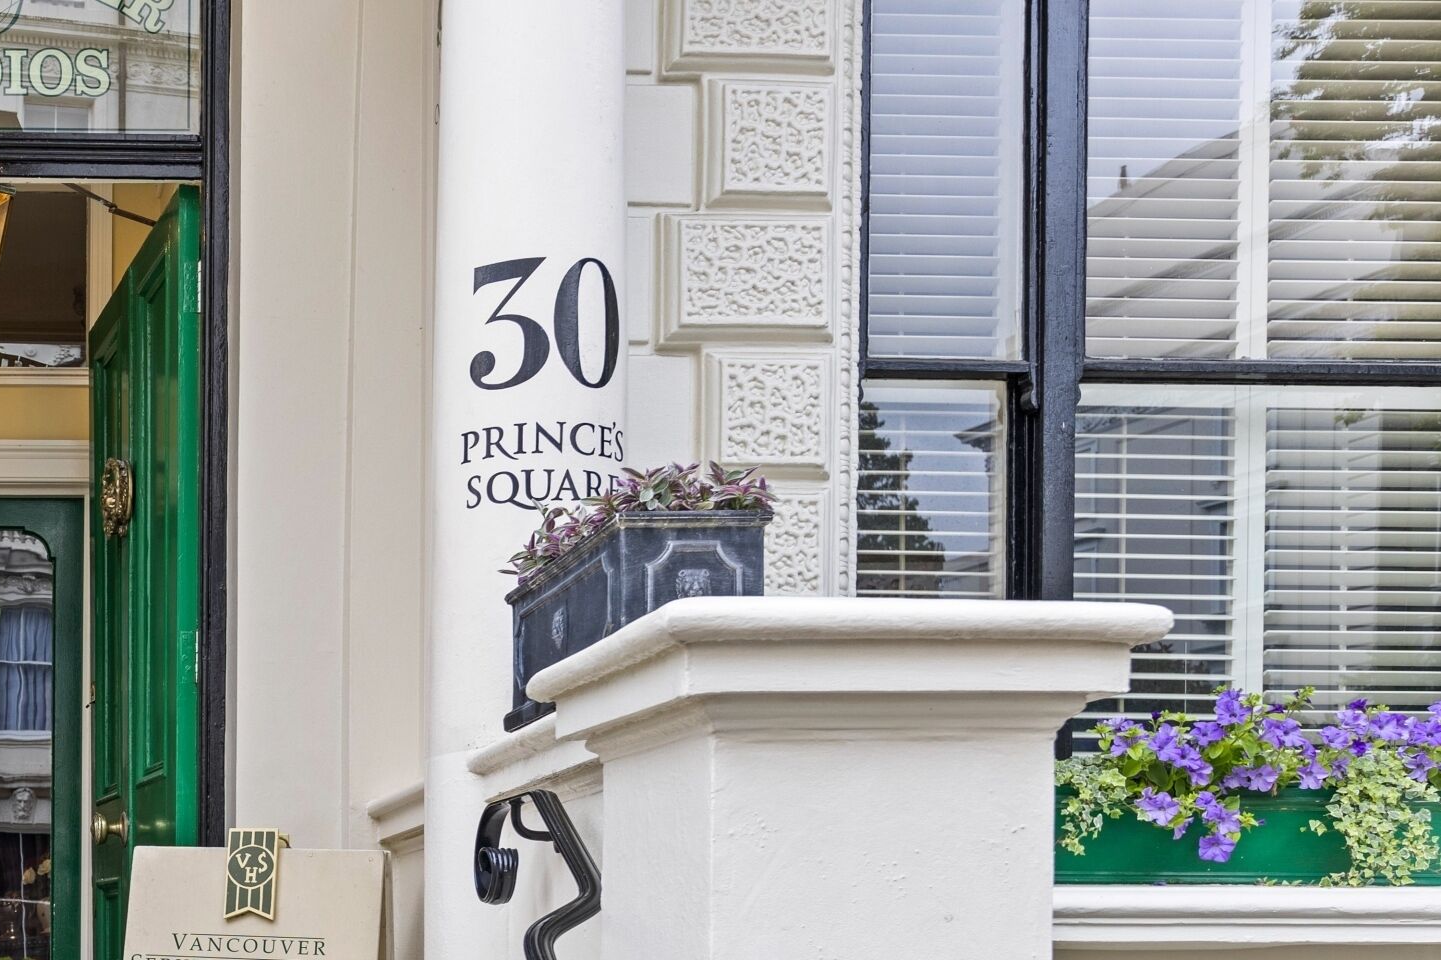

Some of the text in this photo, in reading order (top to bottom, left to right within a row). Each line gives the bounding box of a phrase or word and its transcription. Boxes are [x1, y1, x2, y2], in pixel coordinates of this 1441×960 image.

[469, 256, 620, 390] 30
[460, 421, 624, 465] PRINCE'S
[172, 933, 326, 956] VANCOUVER
